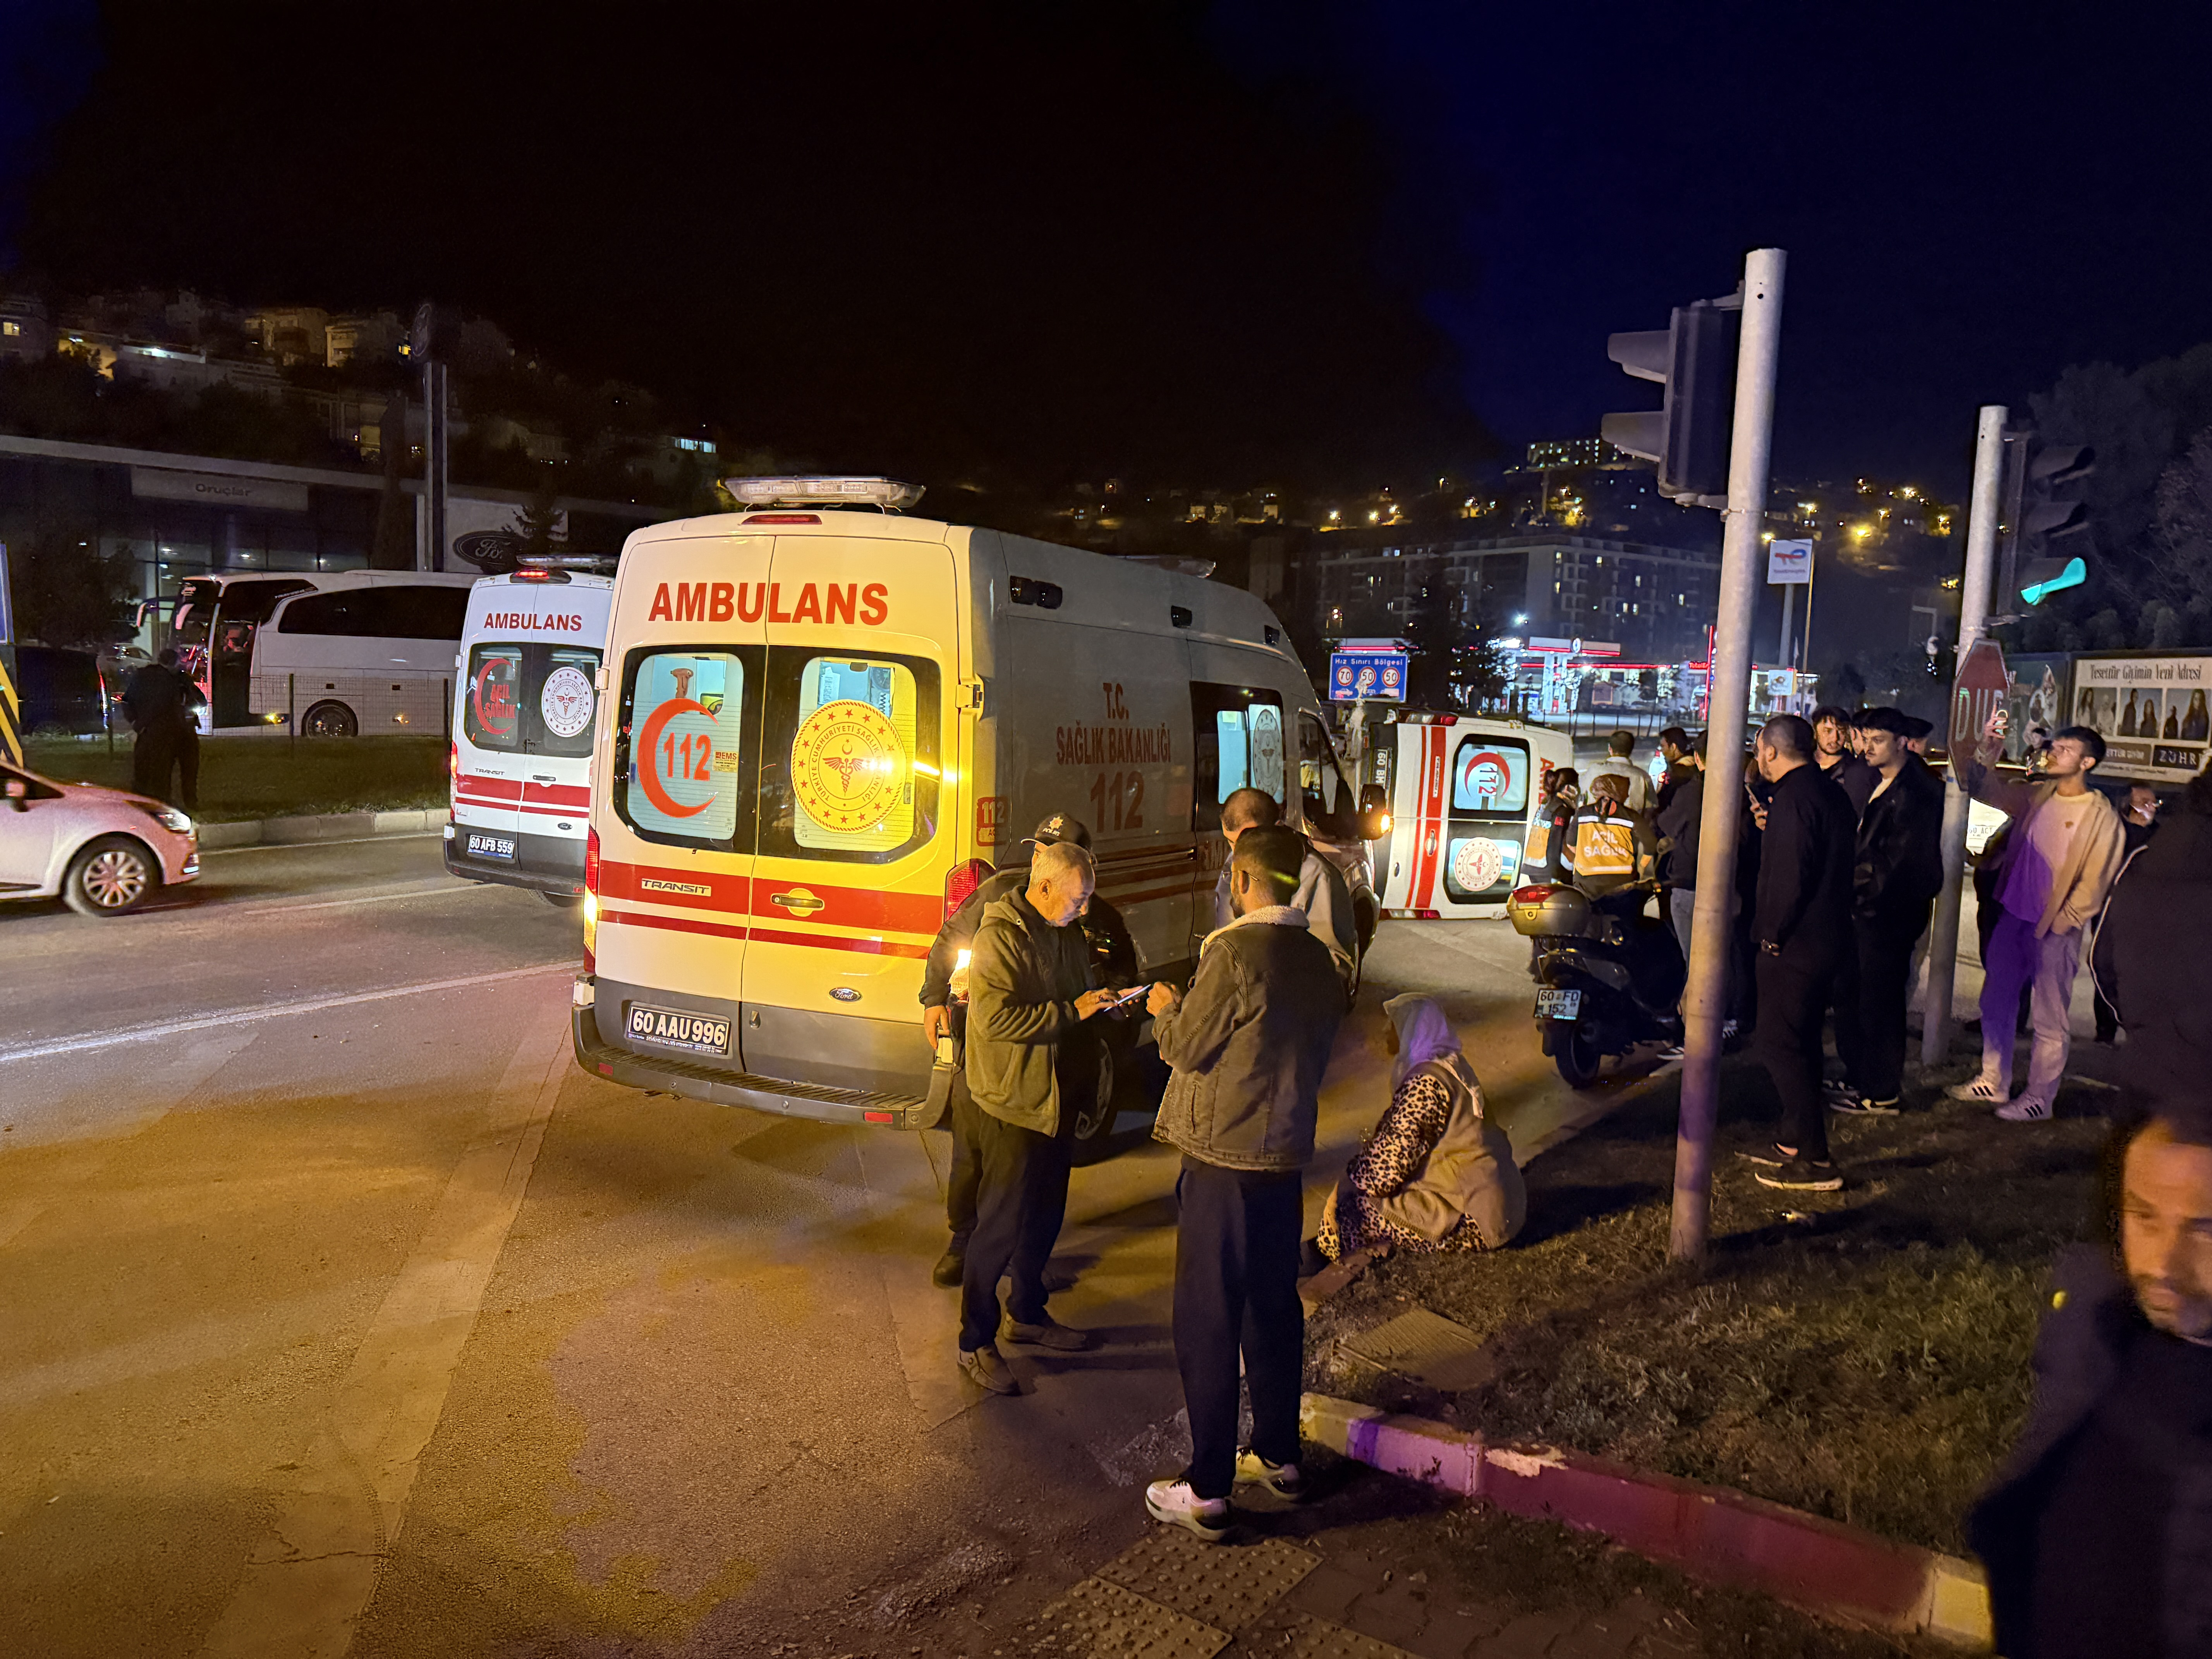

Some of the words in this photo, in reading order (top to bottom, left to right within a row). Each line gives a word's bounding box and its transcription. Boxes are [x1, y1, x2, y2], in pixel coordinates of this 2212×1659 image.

[648, 582, 888, 625] AMBULANS
[484, 613, 582, 631] AMBULANS
[1341, 671, 1350, 680] 70
[1362, 672, 1373, 681] 50
[1386, 672, 1396, 682] 50
[1103, 682, 1129, 720] T.C.
[812, 725, 854, 763] CUMHURİYETİ
[856, 728, 880, 753] SAĞLIK
[1056, 720, 1104, 765] SAĞLIK
[1108, 722, 1171, 764] BAKANLIĞI
[663, 732, 711, 781] 112
[1377, 752, 1386, 766] 60
[812, 766, 830, 801] TÜRKİYE
[1479, 767, 1498, 794] 112
[982, 801, 1004, 824] 112
[1090, 770, 1144, 833] 112
[471, 837, 480, 849] 60
[481, 838, 496, 852] AFB
[497, 841, 513, 854] 559
[642, 880, 709, 894] TRANSIT
[835, 990, 854, 1000] Ford
[1540, 991, 1554, 1001] 60
[633, 1011, 654, 1034] 60
[655, 1015, 691, 1039] AAU
[692, 1020, 725, 1046] 996
